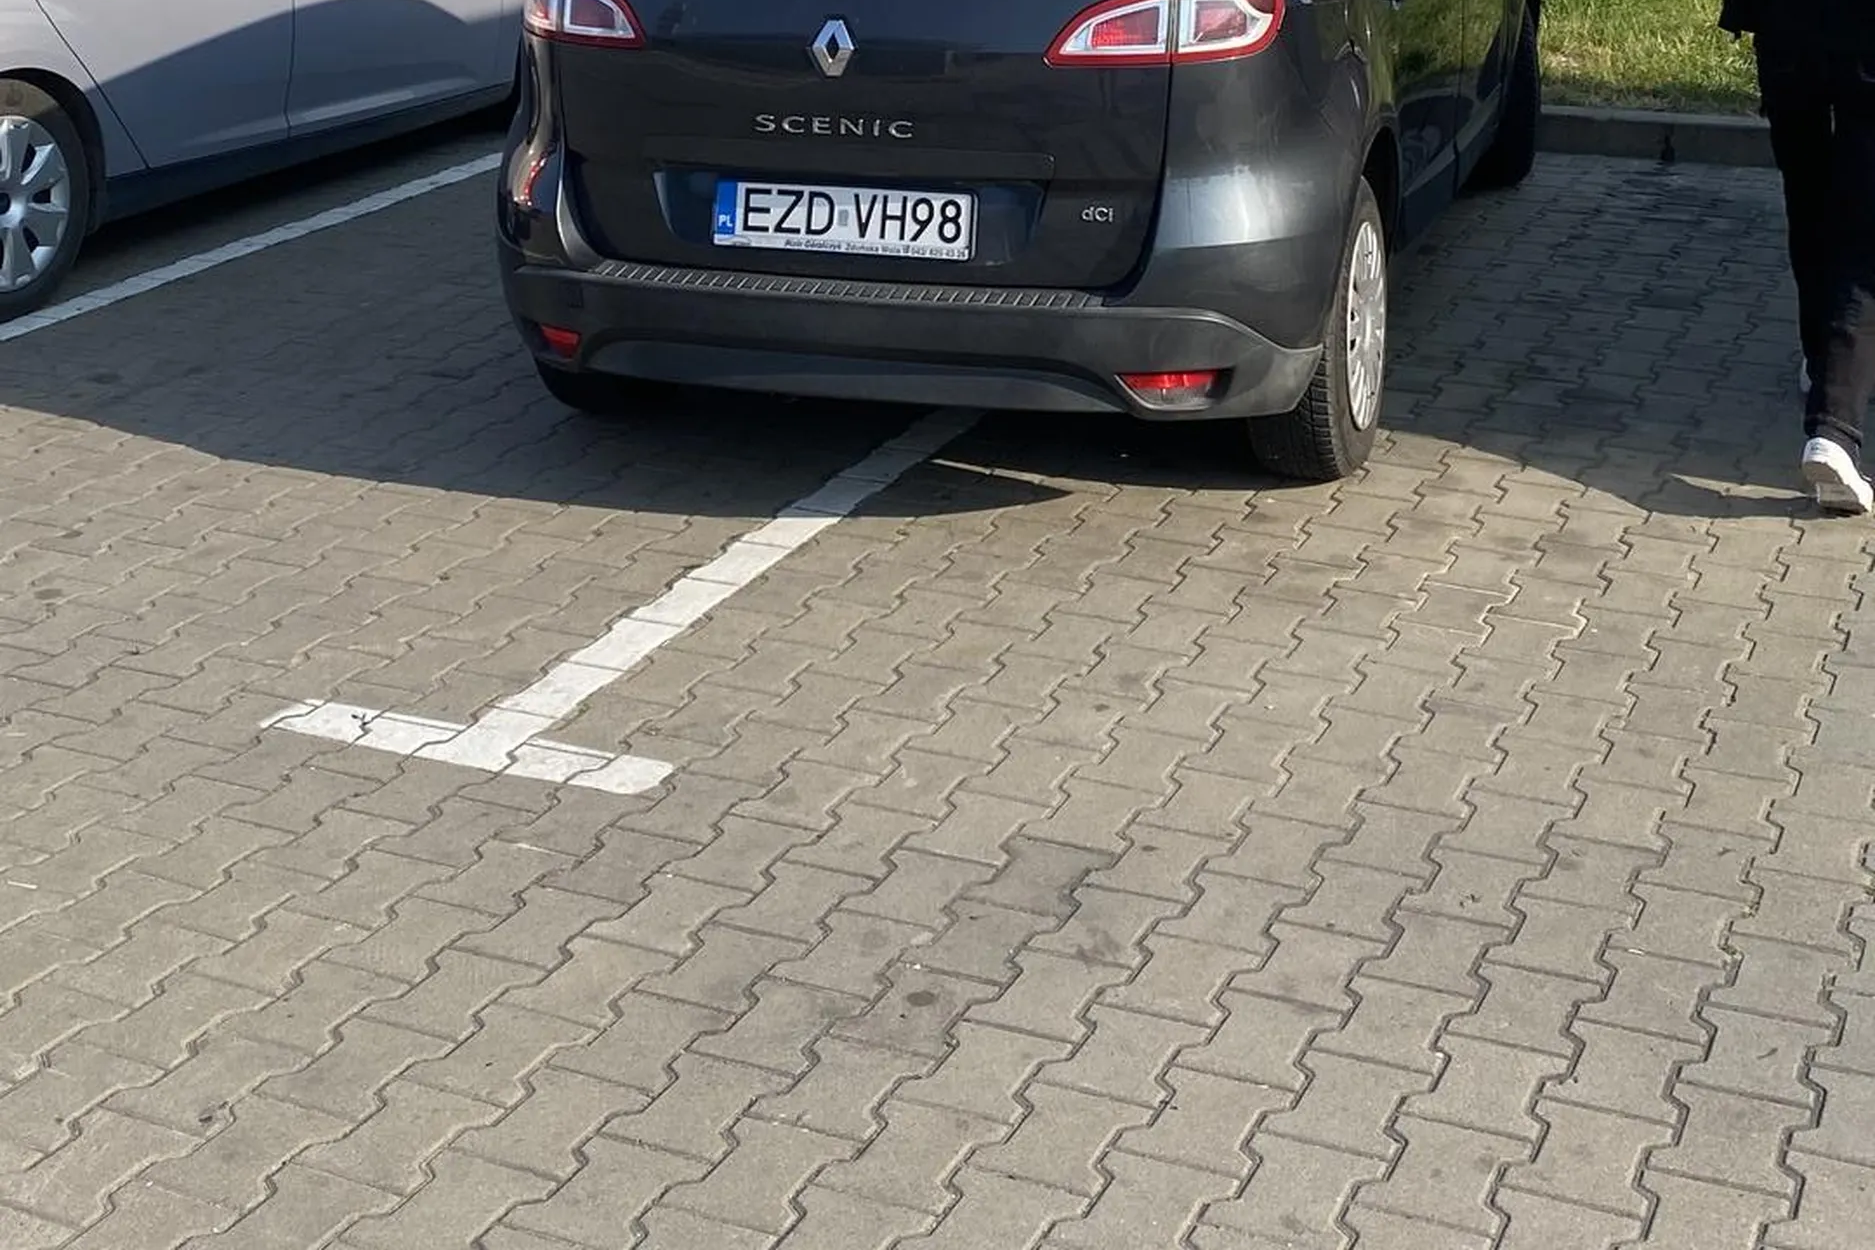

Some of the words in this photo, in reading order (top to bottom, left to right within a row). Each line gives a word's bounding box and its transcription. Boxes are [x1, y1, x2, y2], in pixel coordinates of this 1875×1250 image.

[754, 114, 913, 138] SCENIC
[719, 214, 734, 228] PL
[742, 187, 835, 236] EZD
[853, 193, 962, 244] VH98
